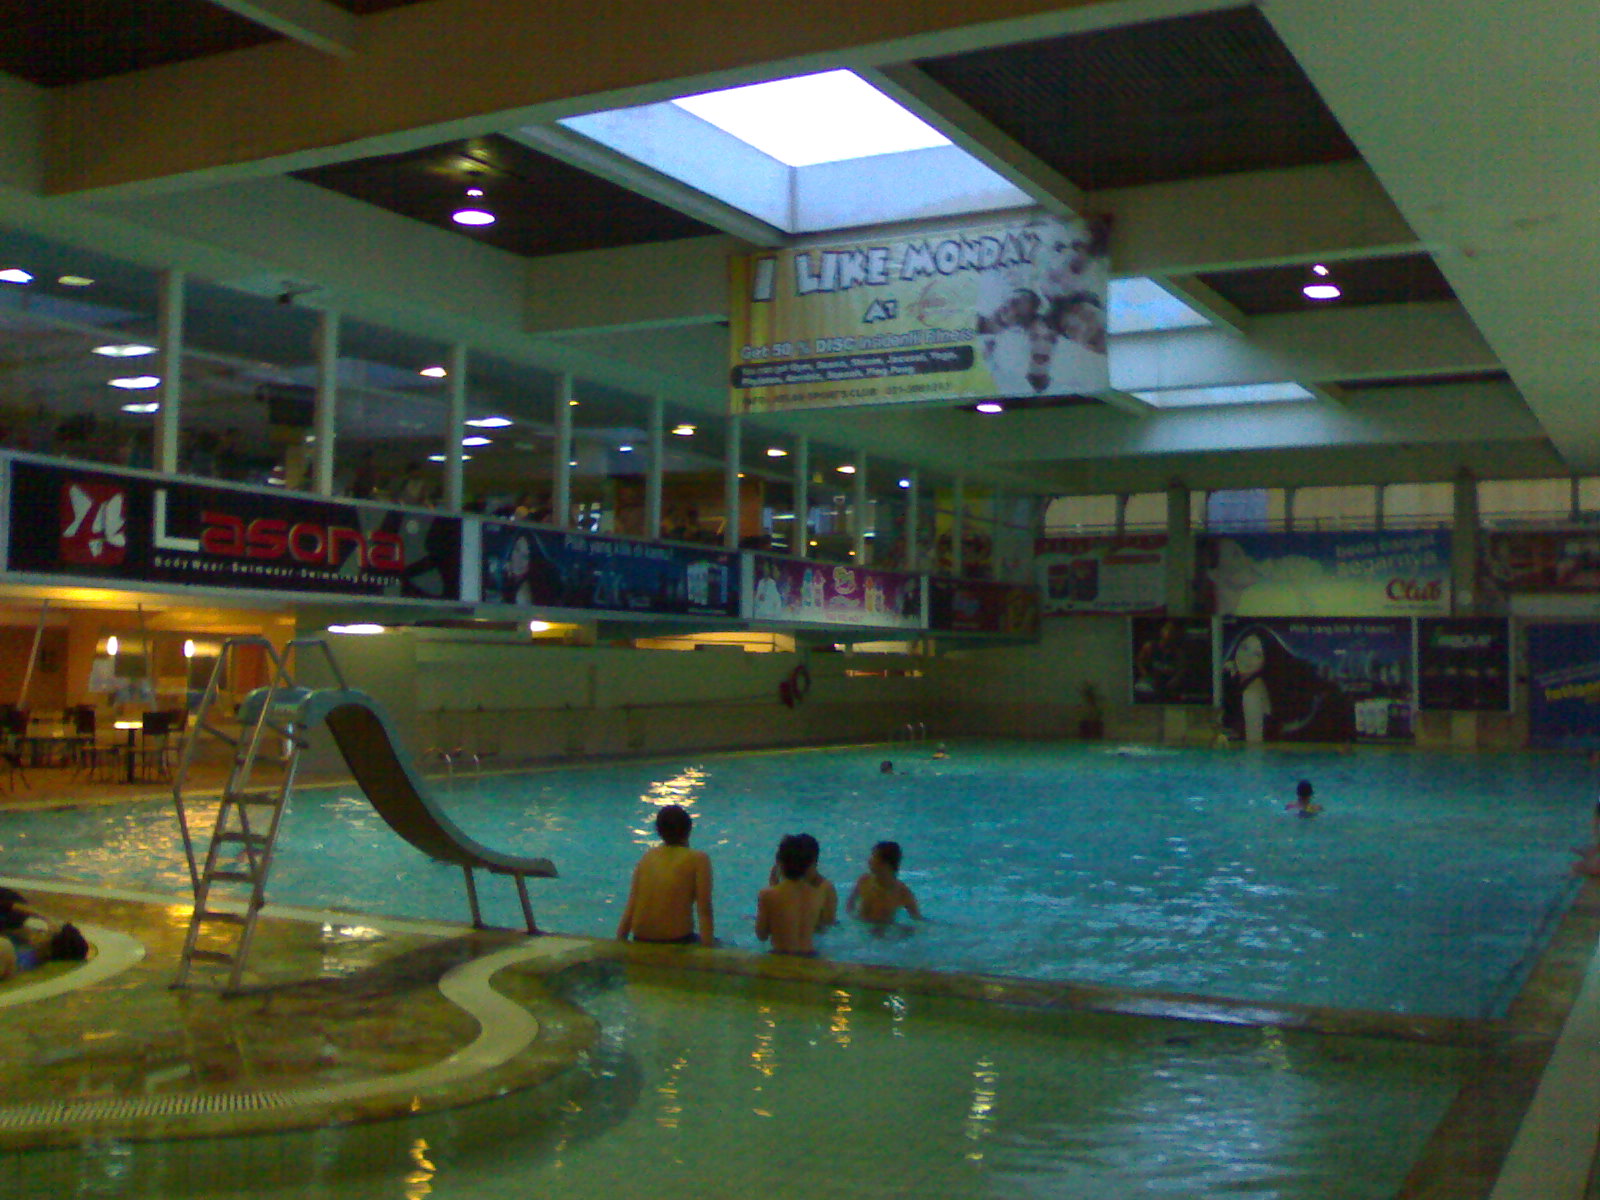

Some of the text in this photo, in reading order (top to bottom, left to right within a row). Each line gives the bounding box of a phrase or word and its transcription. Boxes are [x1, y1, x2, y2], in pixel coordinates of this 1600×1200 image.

[751, 229, 1041, 302] I LIKE MONDAY
[862, 298, 898, 324] AT
[815, 335, 856, 355] DISC
[153, 488, 405, 571] Lasona
[1385, 577, 1443, 602] Club
